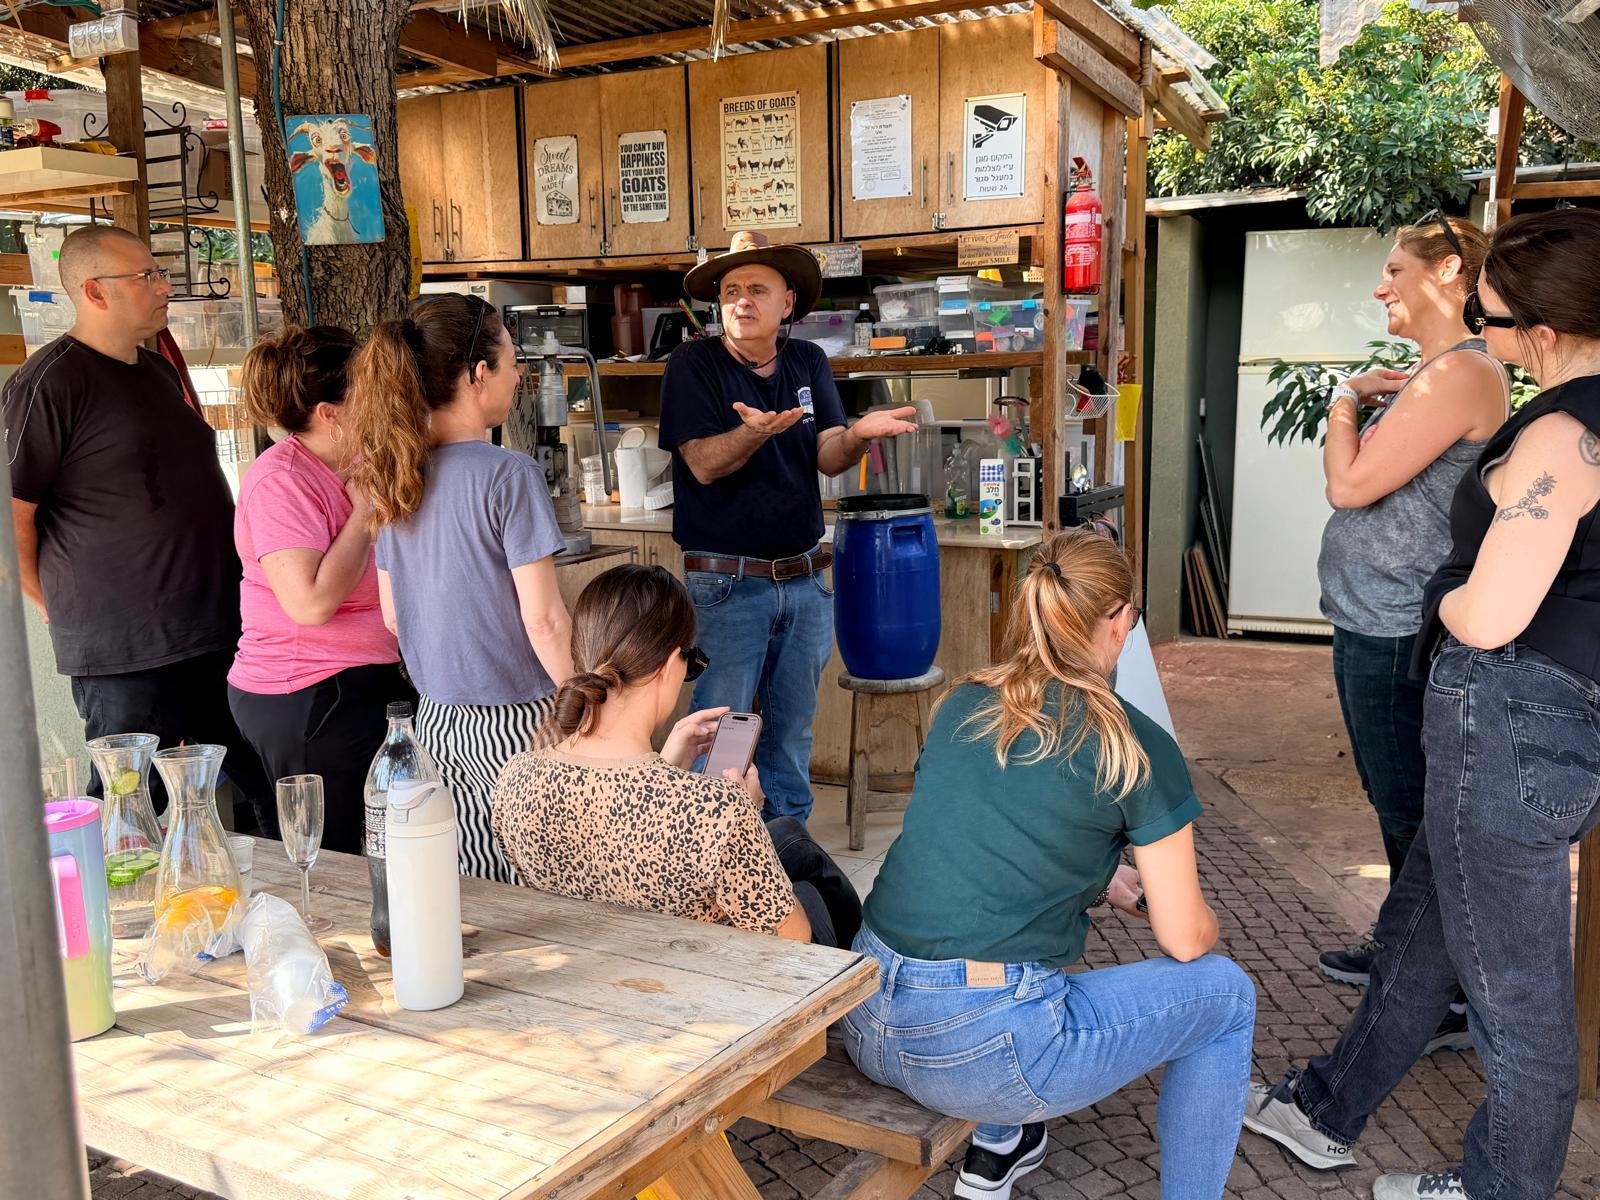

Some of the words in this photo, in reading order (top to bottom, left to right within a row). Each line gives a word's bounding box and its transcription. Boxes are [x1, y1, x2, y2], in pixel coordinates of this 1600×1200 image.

[724, 101, 755, 113] BREEDS
[757, 99, 767, 109] OF
[770, 96, 796, 108] GOATS
[620, 144, 632, 153] YOU
[633, 142, 651, 152] CAN'T
[652, 142, 665, 151] BUY
[620, 151, 665, 168] HAPPINESS
[990, 153, 1013, 162] המקום
[537, 163, 574, 178] DREAMS
[621, 169, 631, 178] BUT
[632, 169, 642, 177] YOU
[643, 168, 654, 176] CAN
[655, 167, 665, 175] BUY
[975, 165, 1001, 173] מצלמות
[541, 181, 557, 192] MADE
[622, 176, 666, 193] GOATS
[634, 194, 652, 202] THAT'S
[653, 193, 667, 201] KIND
[623, 204, 629, 212] OF
[630, 203, 639, 211] THE
[640, 202, 652, 211] SAME
[652, 201, 666, 210] THING
